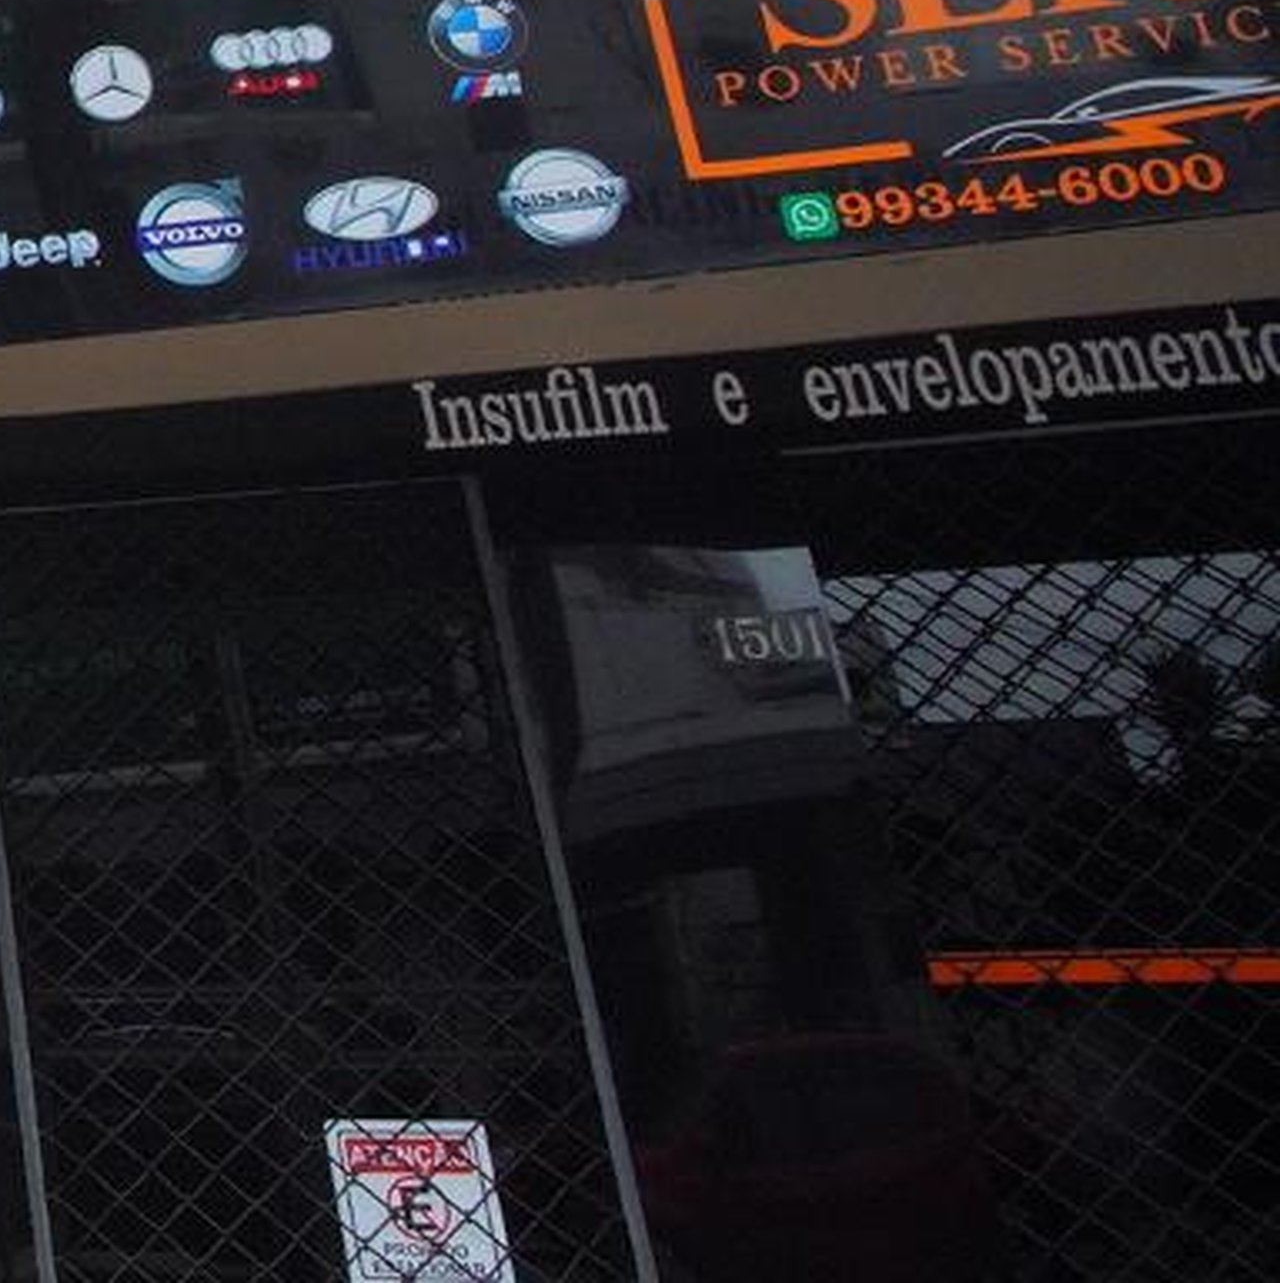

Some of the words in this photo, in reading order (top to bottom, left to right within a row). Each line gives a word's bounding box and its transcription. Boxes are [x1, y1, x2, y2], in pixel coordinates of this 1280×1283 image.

[713, 45, 969, 107] POWER
[998, 1, 1280, 73] SERVIC
[510, 185, 617, 210] NISSAN
[836, 154, 1225, 230] 99344-6000
[143, 222, 243, 245] VOLVO
[412, 367, 668, 451] Insufilm
[713, 369, 749, 426] e
[714, 614, 827, 663] 1501
